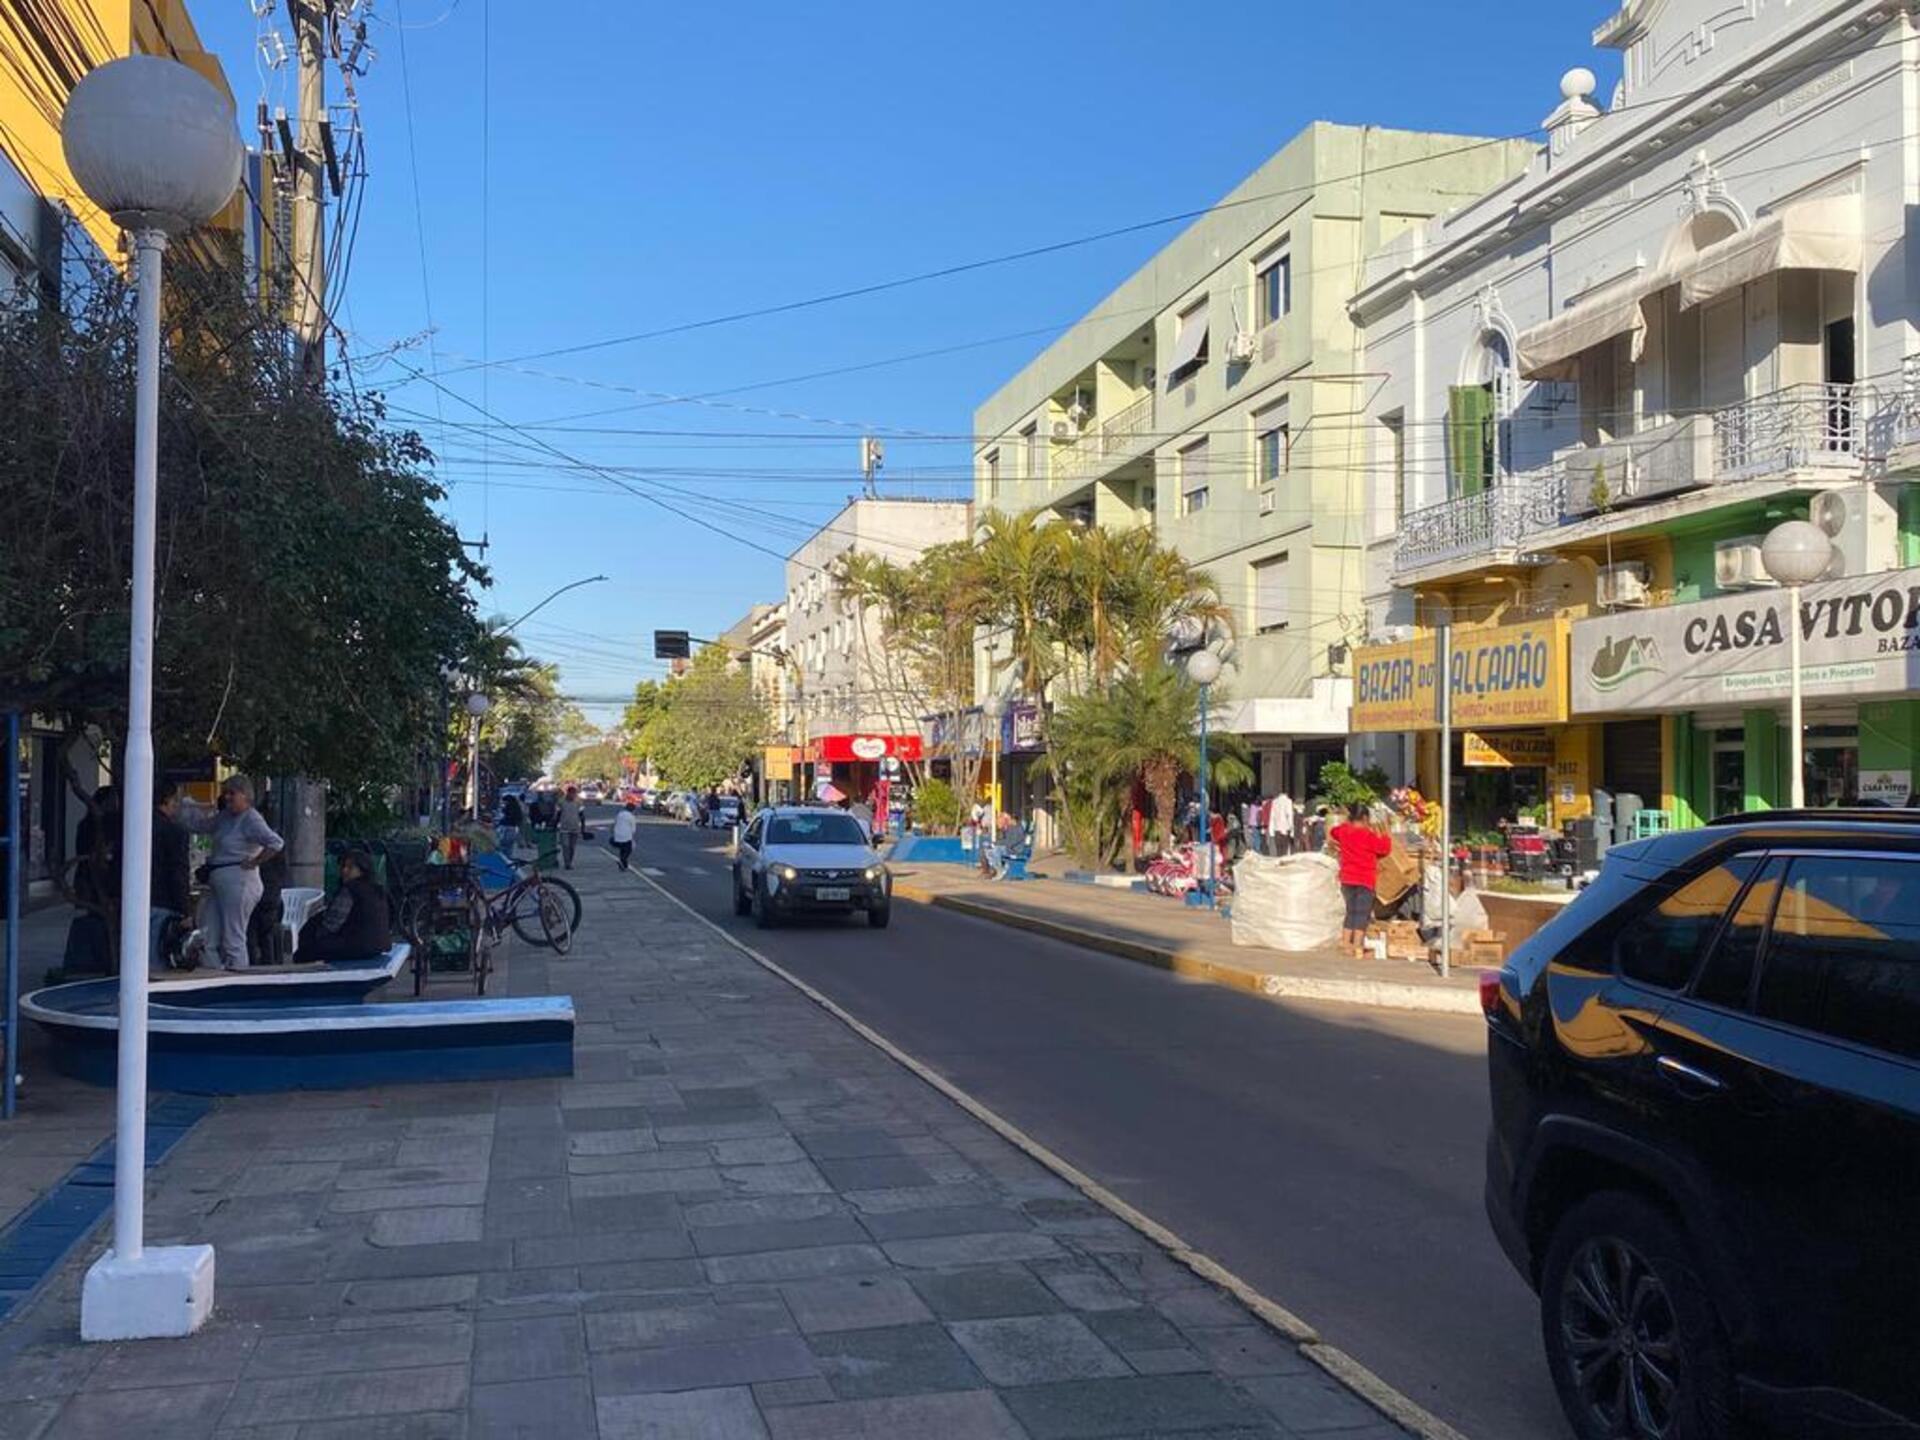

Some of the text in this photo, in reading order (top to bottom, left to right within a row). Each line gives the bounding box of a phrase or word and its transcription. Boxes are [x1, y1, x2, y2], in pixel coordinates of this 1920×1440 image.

[1683, 606, 1784, 655] CASA
[1359, 631, 1547, 703] BAZAR DO ALÇADÃO
